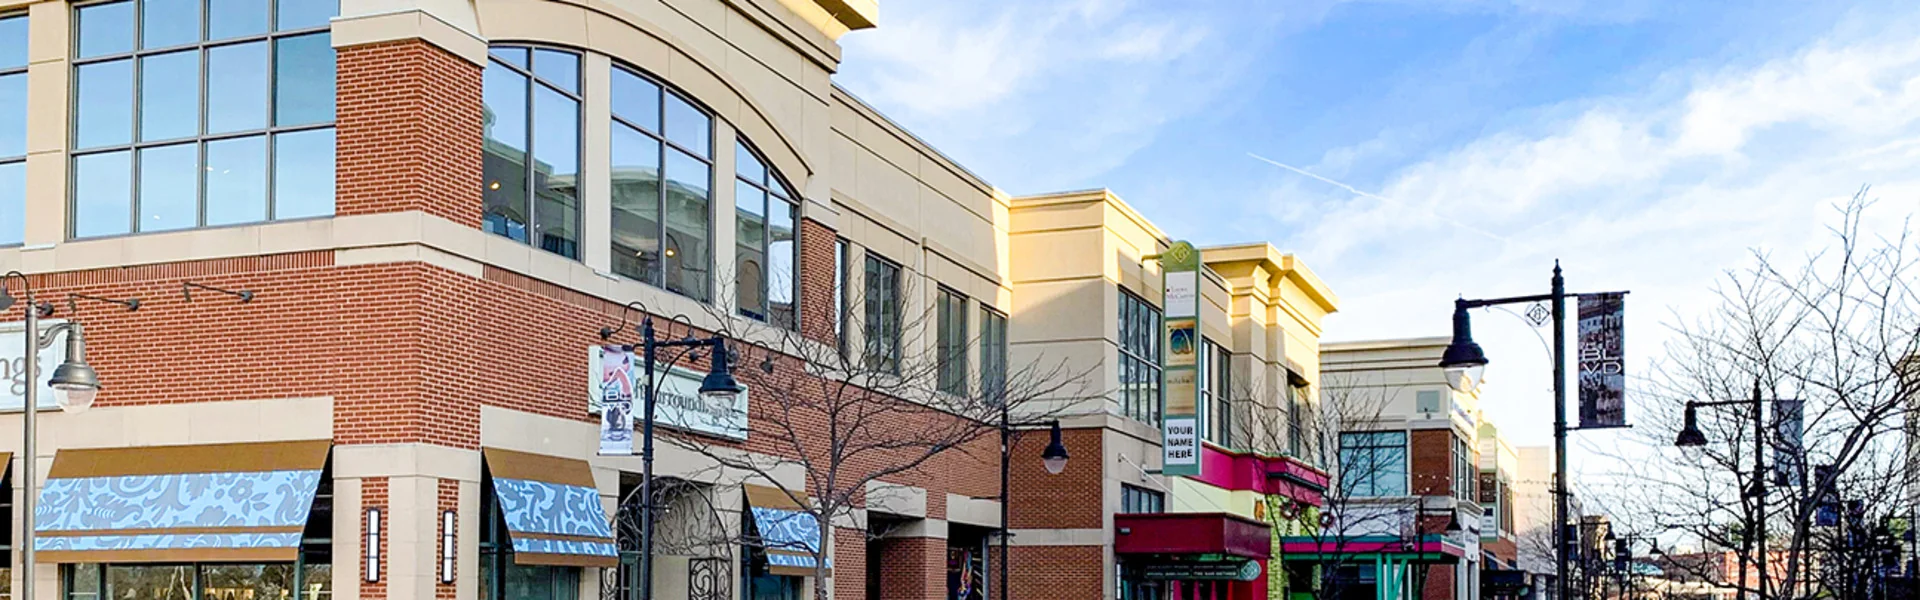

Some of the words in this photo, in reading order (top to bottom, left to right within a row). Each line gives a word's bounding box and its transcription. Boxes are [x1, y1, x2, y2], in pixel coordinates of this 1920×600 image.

[1582, 348, 1620, 360] BL
[1582, 361, 1622, 374] VD
[1168, 426, 1193, 435] YOUR
[1168, 437, 1194, 447] NAME
[1168, 448, 1193, 459] HERE
